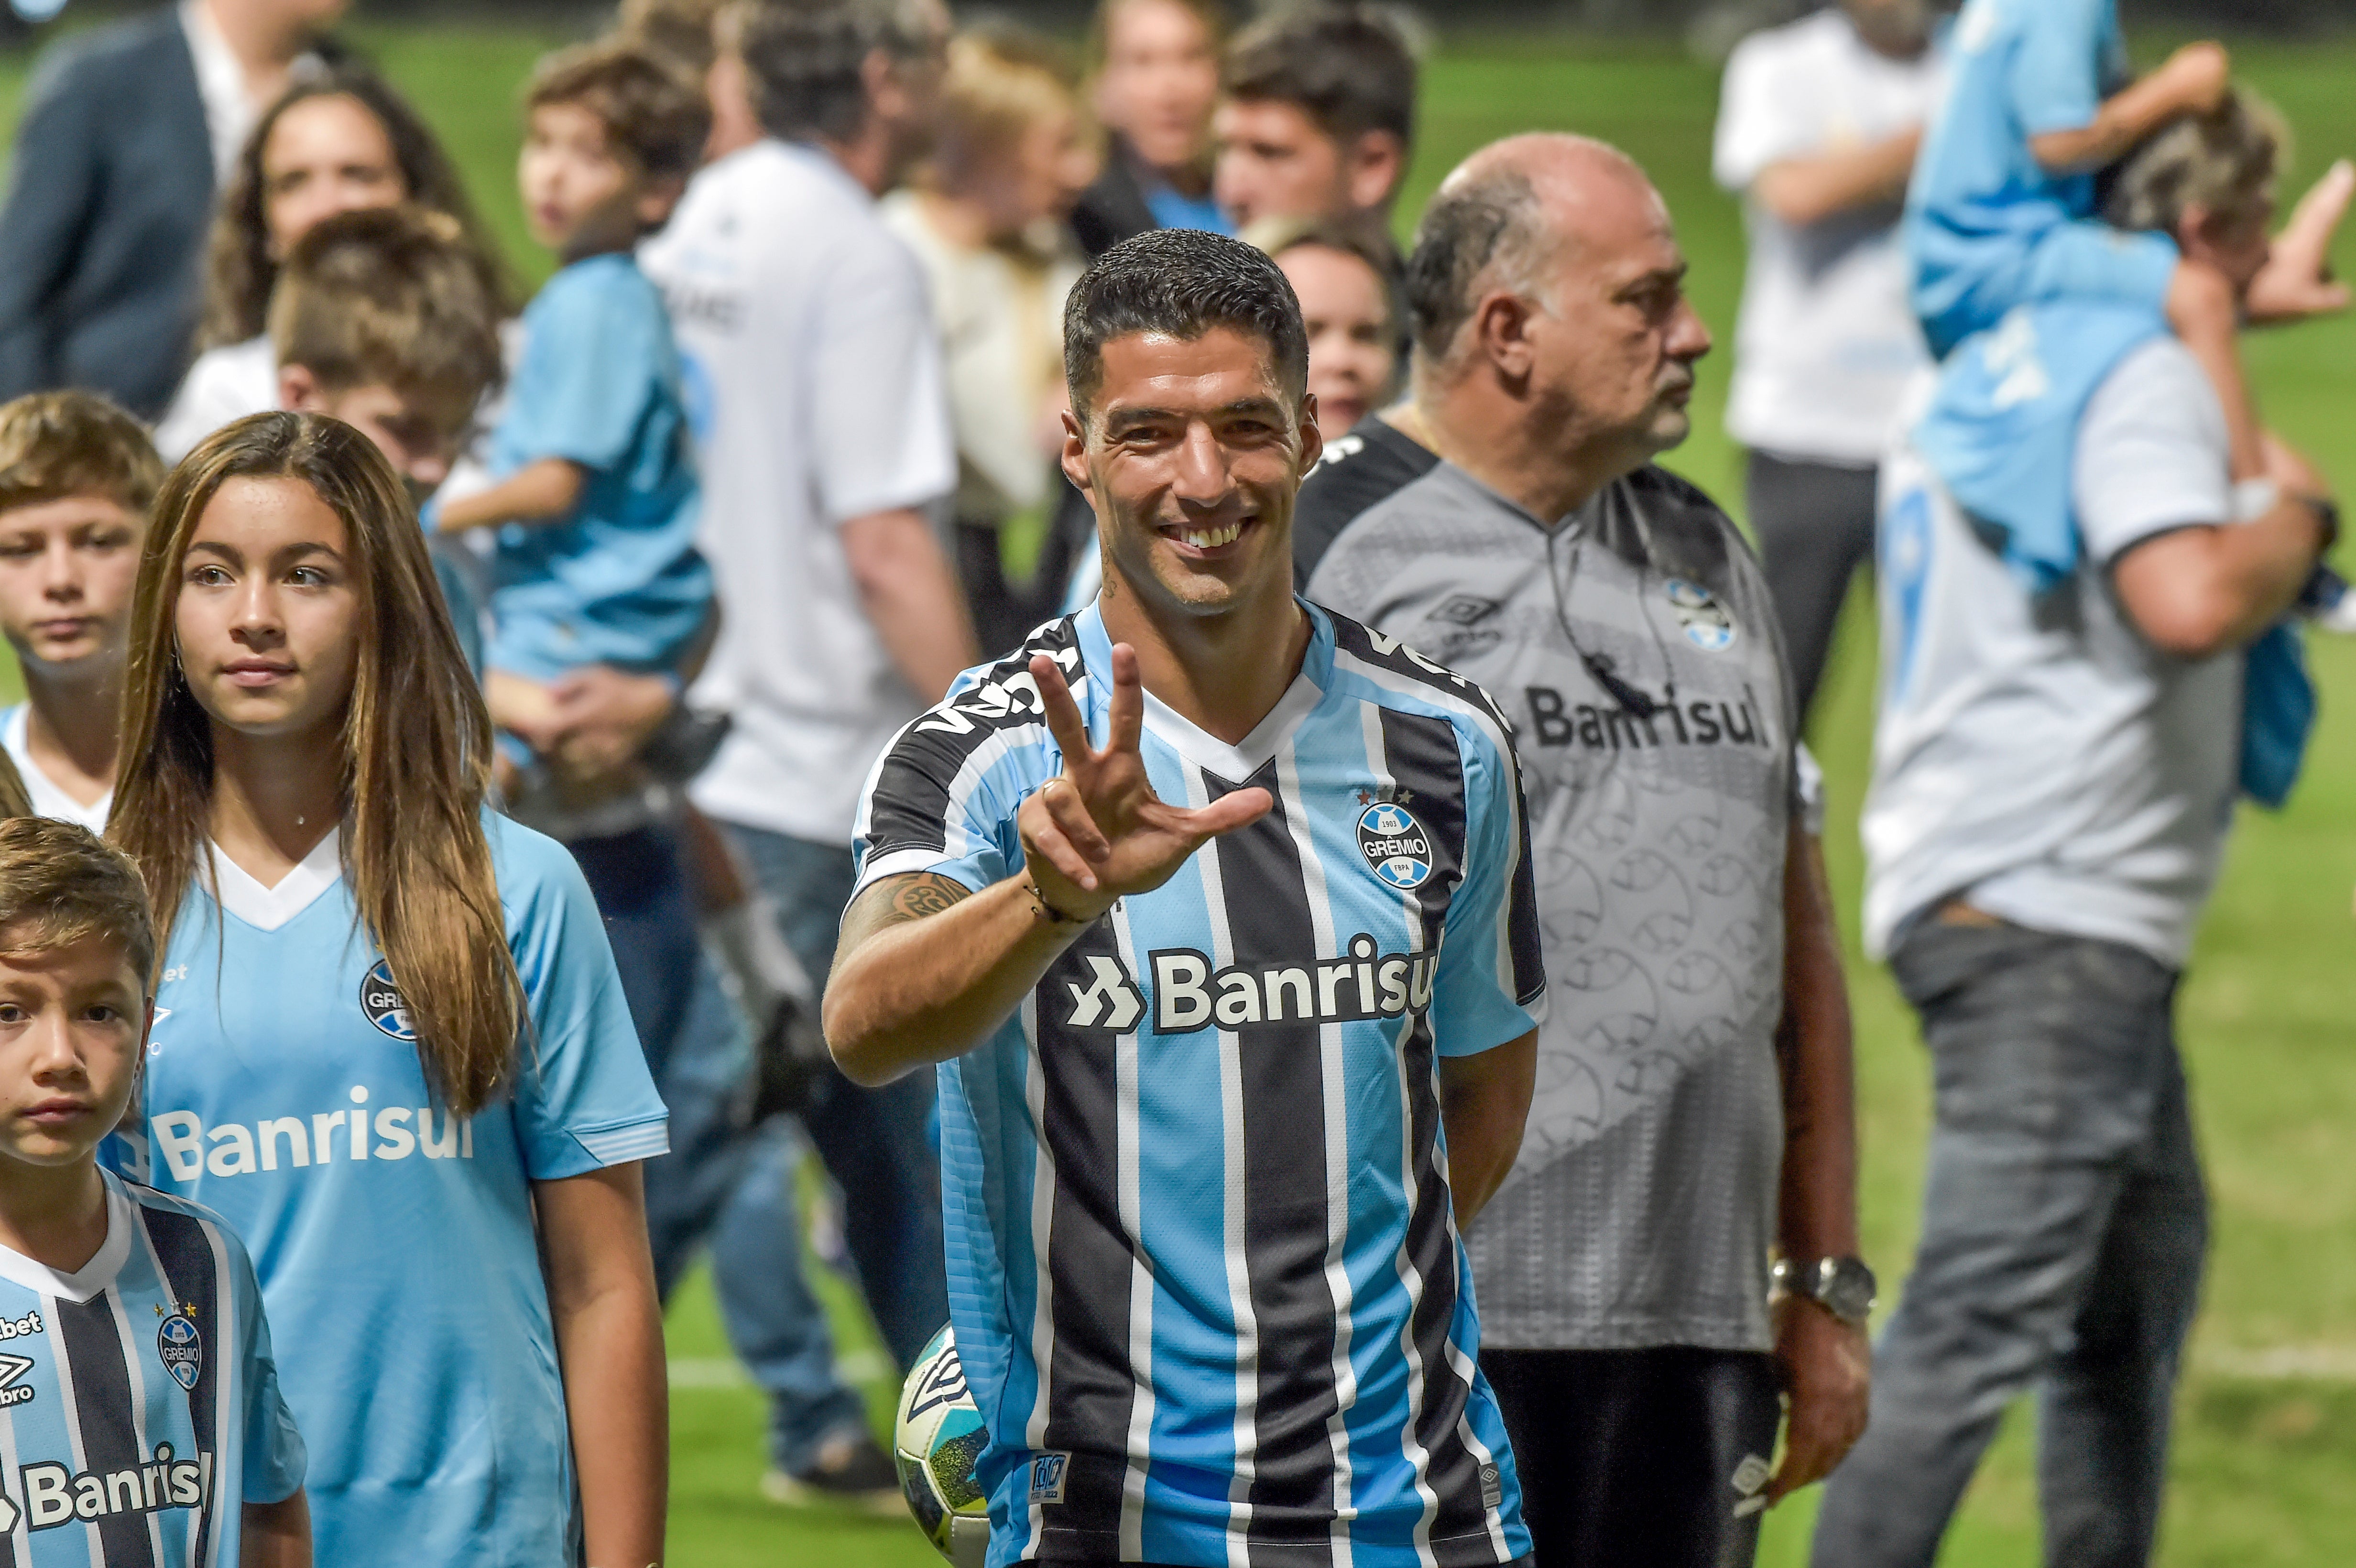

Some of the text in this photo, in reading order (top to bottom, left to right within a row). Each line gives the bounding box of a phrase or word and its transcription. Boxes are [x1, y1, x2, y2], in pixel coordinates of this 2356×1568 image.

[1363, 835, 1427, 857] GRÊMIO
[151, 1085, 473, 1182] Banrisul
[164, 1343, 198, 1361] GRÊMIO
